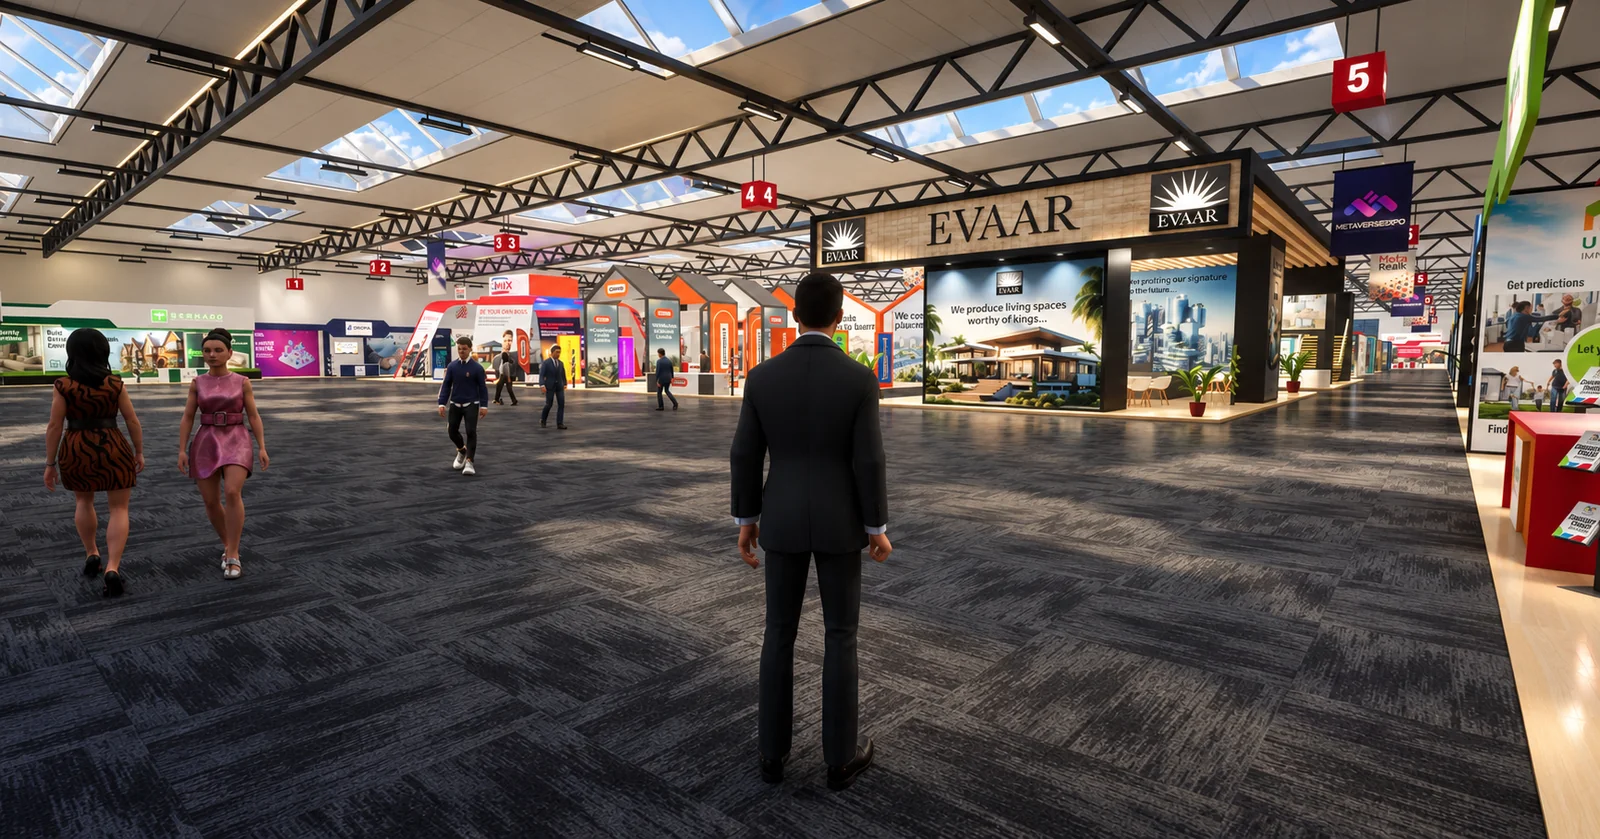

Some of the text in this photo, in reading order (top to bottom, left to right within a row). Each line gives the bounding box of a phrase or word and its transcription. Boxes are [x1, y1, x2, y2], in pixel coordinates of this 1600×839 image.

[1347, 61, 1370, 93] 5
[746, 185, 755, 202] 4
[764, 186, 773, 203] 4
[926, 194, 1080, 247] EVAAR
[1157, 208, 1218, 229] EVAAR
[496, 239, 502, 249] 3
[509, 238, 516, 249] 3
[826, 249, 859, 263] EVAAR
[381, 262, 386, 272] 2
[294, 280, 299, 288] 1
[1187, 274, 1228, 284] signature
[1507, 278, 1585, 292] Get predictions
[951, 300, 1067, 315] We produce living spaces
[895, 312, 908, 320] We
[968, 316, 1000, 326] worthy
[1001, 314, 1012, 324] of
[1577, 344, 1594, 353] Let
[1488, 424, 1508, 434] Find
